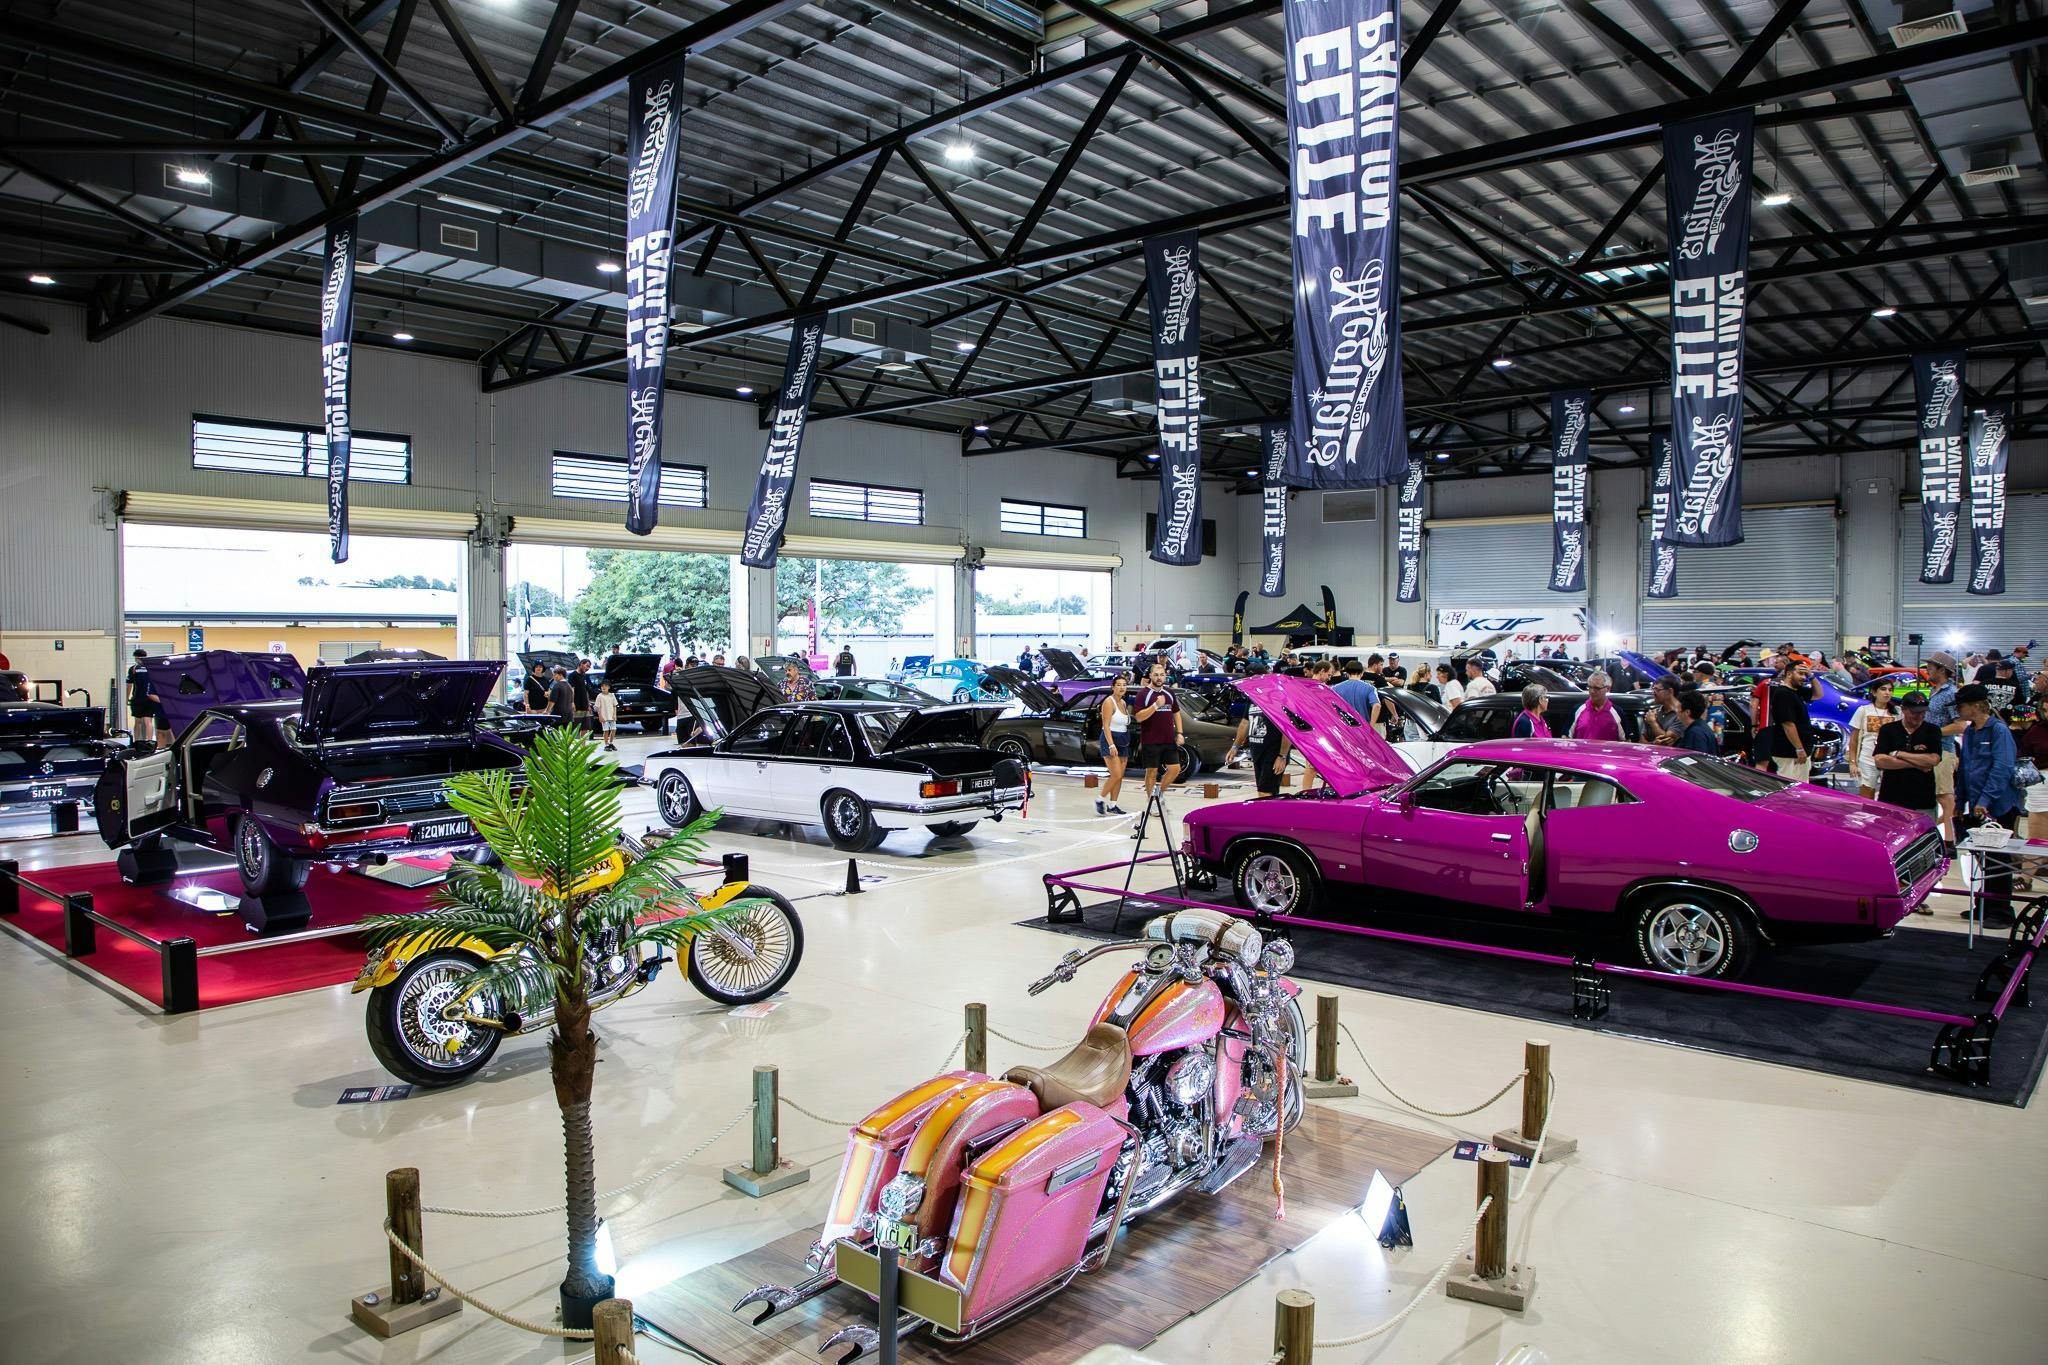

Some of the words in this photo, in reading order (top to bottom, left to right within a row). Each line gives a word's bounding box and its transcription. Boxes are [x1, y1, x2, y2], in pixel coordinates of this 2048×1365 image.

[974, 778, 996, 789] HELBENT
[425, 821, 468, 839] 2QWIK4U
[1640, 909, 1652, 925] T/A
[1637, 930, 1653, 965] Radial
[1715, 910, 1734, 975] BFGoodrich
